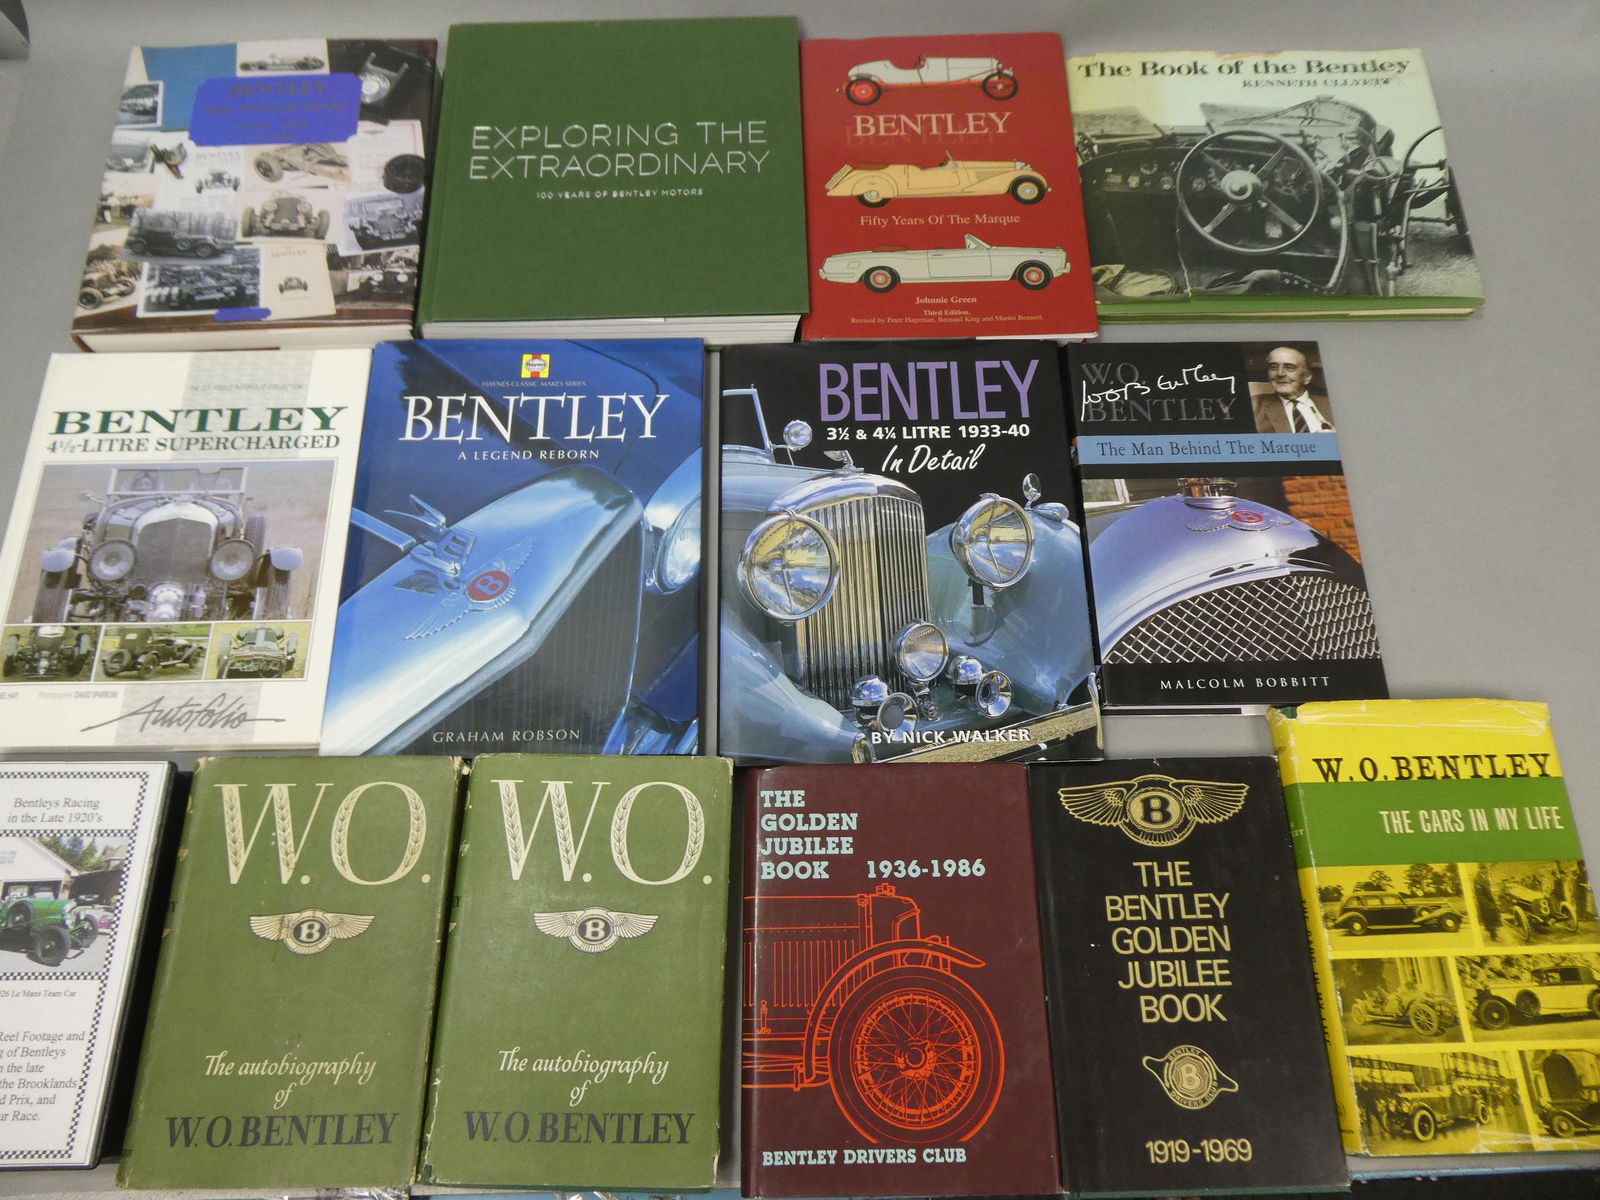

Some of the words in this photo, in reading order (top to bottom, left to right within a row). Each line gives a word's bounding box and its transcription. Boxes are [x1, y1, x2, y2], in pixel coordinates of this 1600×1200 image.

[1078, 63, 1132, 78] The
[1141, 60, 1209, 76] Book
[1217, 60, 1245, 75] of
[1253, 60, 1298, 74] the
[1305, 58, 1411, 75] Bentley
[853, 111, 1013, 137] BENTLEY
[472, 122, 678, 149] EXPLORING
[696, 121, 767, 145] THE
[469, 150, 770, 179] EXTRAORDINARY
[536, 191, 554, 200] 100
[557, 190, 591, 199] YEARS
[595, 190, 608, 199] OF
[612, 189, 658, 198] BENTLEY
[661, 188, 703, 197] MOTORS
[860, 216, 889, 228] Fifty
[891, 215, 925, 226] Years
[928, 214, 946, 225] Of
[948, 214, 971, 225] The
[974, 213, 1021, 227] Marque
[915, 296, 949, 305] Johnnie
[950, 296, 978, 304] Green
[851, 317, 876, 325] Revised
[877, 317, 886, 325] by
[887, 316, 903, 324] Peter
[964, 315, 980, 325] King
[995, 314, 1017, 322] Martin
[923, 309, 943, 317] Third
[819, 359, 1039, 422] BENTLEY
[398, 392, 670, 444] BENTLEY
[1086, 397, 1237, 423] BENTLEY
[48, 406, 349, 435] BENTLEY
[855, 429, 868, 440] &
[902, 425, 951, 439] LITRE
[958, 424, 1030, 438] 1933-40
[155, 434, 341, 451] SUPERCHARGED
[1097, 442, 1125, 457] The
[1131, 441, 1164, 456] Man
[1169, 441, 1221, 456] Behind
[1226, 440, 1255, 455] The
[1261, 440, 1317, 457] Marque
[458, 451, 467, 461] A
[474, 450, 533, 461] LEGEND
[540, 449, 600, 460] REBORN
[881, 444, 901, 473] In
[907, 443, 986, 474] Detail
[1160, 678, 1245, 690] MALCOLM
[1255, 676, 1329, 688] BOBBITT
[80, 692, 286, 733] Autofolio
[432, 731, 505, 744] GRAHAM
[512, 729, 582, 743] ROBSON
[871, 731, 894, 744] BY
[902, 730, 946, 744] NICK
[952, 729, 1032, 743] WALKER
[13, 797, 60, 810] Bentleys
[63, 797, 100, 810] Racing
[760, 790, 806, 808] THE
[1140, 794, 1173, 824] B
[7, 813, 18, 823] in
[20, 813, 37, 823] the
[40, 813, 64, 823] Late
[67, 812, 103, 823] 1920's
[760, 813, 858, 832] GOLDEN
[1378, 810, 1415, 834] THE
[1418, 808, 1465, 833] CARS
[1469, 808, 1490, 832] IN
[1493, 807, 1519, 831] MY
[1524, 806, 1565, 830] LIFE
[213, 781, 432, 886] W.O.
[490, 779, 713, 886] W.O.
[760, 836, 854, 855] JUBILEE
[760, 861, 830, 880] BOOK
[867, 858, 986, 878] 1936-1986
[1132, 860, 1193, 887] THE
[1105, 892, 1230, 922] BENTLEY
[1540, 899, 1550, 915] 8
[300, 920, 322, 944] B
[584, 917, 607, 941] B
[1111, 925, 1231, 955] GOLDEN
[1118, 959, 1233, 989] JUBILEE
[43, 989, 63, 997] Team
[64, 989, 76, 997] Car
[1140, 993, 1228, 1024] BOOK
[22, 1031, 63, 1044] Footage
[66, 1031, 86, 1041] and
[6, 1046, 20, 1058] of
[21, 1046, 66, 1060] Bentleys
[1168, 1047, 1201, 1061] BENTLEY
[7, 1063, 23, 1073] the
[25, 1062, 45, 1073] late
[205, 1050, 235, 1077] The
[238, 1051, 377, 1084] autobiography
[498, 1047, 527, 1073] The
[532, 1050, 670, 1084] autobiography
[17, 1078, 77, 1089] Brooklands
[1180, 1062, 1201, 1090] B
[9, 1094, 33, 1106] Prix,
[36, 1094, 56, 1105] and
[274, 1083, 297, 1110] of
[570, 1080, 593, 1107] of
[11, 1110, 40, 1121] Race.
[762, 1149, 837, 1166] BENTLEY
[843, 1148, 917, 1164] DRIVERS
[923, 1148, 967, 1164] CLUB
[1145, 1137, 1253, 1164] 1919-1969
